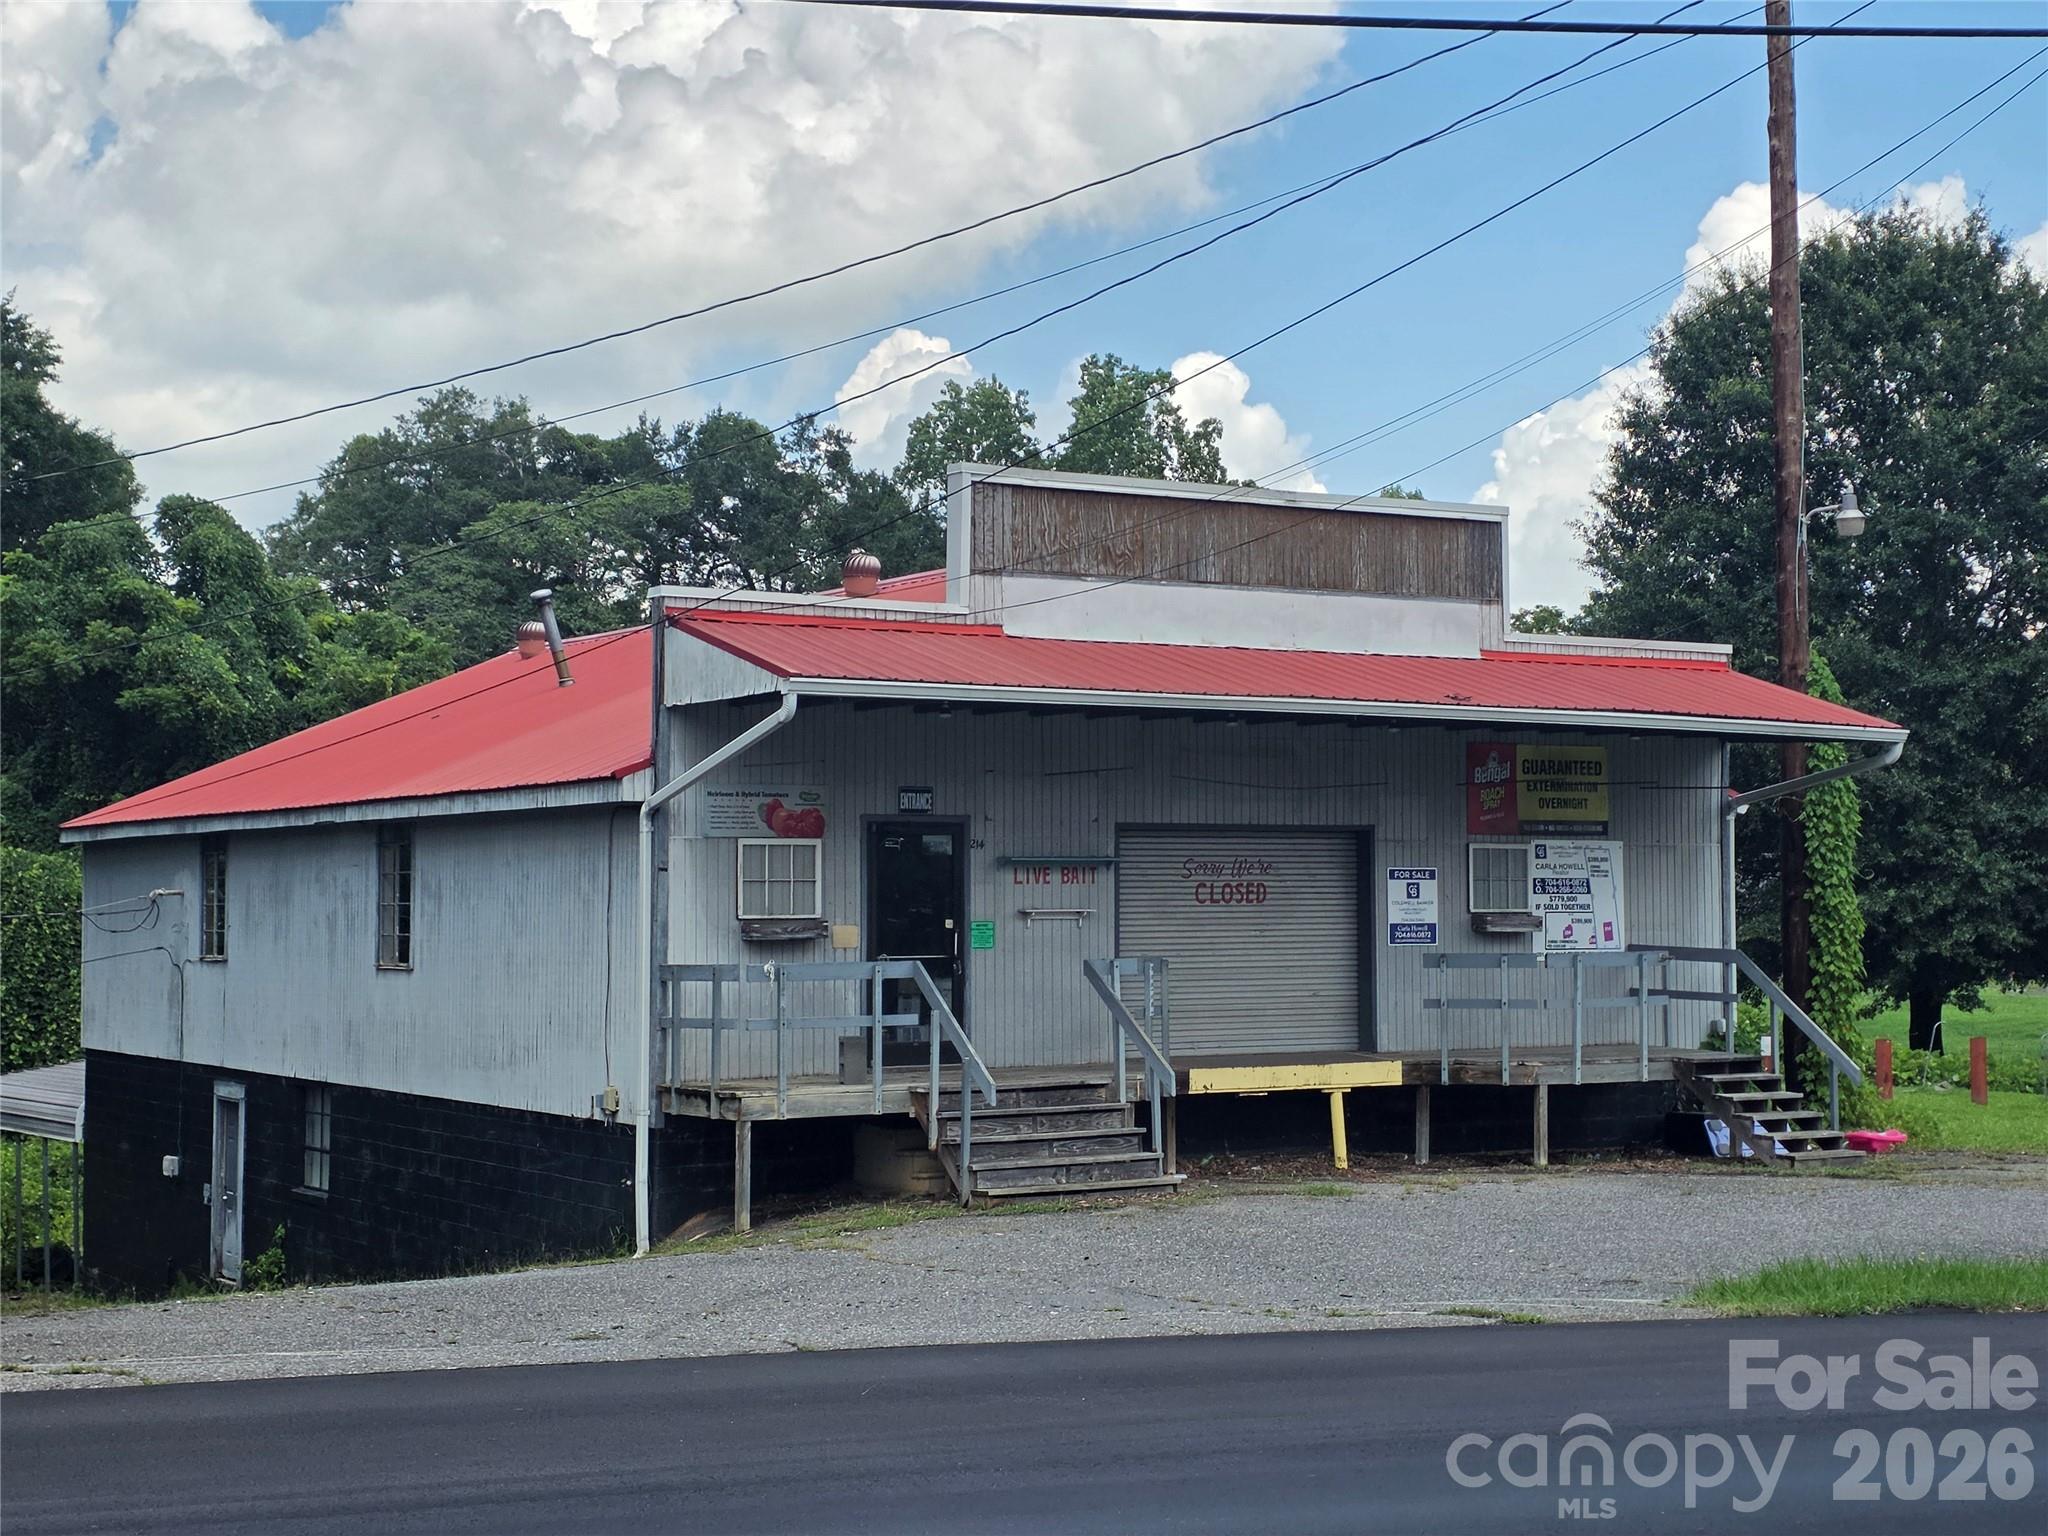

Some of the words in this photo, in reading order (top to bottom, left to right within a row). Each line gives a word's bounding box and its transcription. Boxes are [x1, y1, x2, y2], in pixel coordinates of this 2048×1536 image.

[1474, 760, 1511, 784] Bengal
[1521, 759, 1603, 777] GUARANTEED
[1480, 785, 1505, 802] ROACH
[1526, 780, 1599, 793] EXTERMINATION
[900, 792, 932, 811] ENTRANCE
[1538, 797, 1589, 810] OVERNIGHT
[970, 838, 985, 849] 214
[1014, 866, 1051, 885] LIVE
[1061, 866, 1097, 885] BAIT
[1181, 858, 1225, 879] Sorry
[1394, 870, 1410, 879] FOR
[1412, 870, 1430, 879] SALE
[1195, 882, 1267, 904] CLOSED
